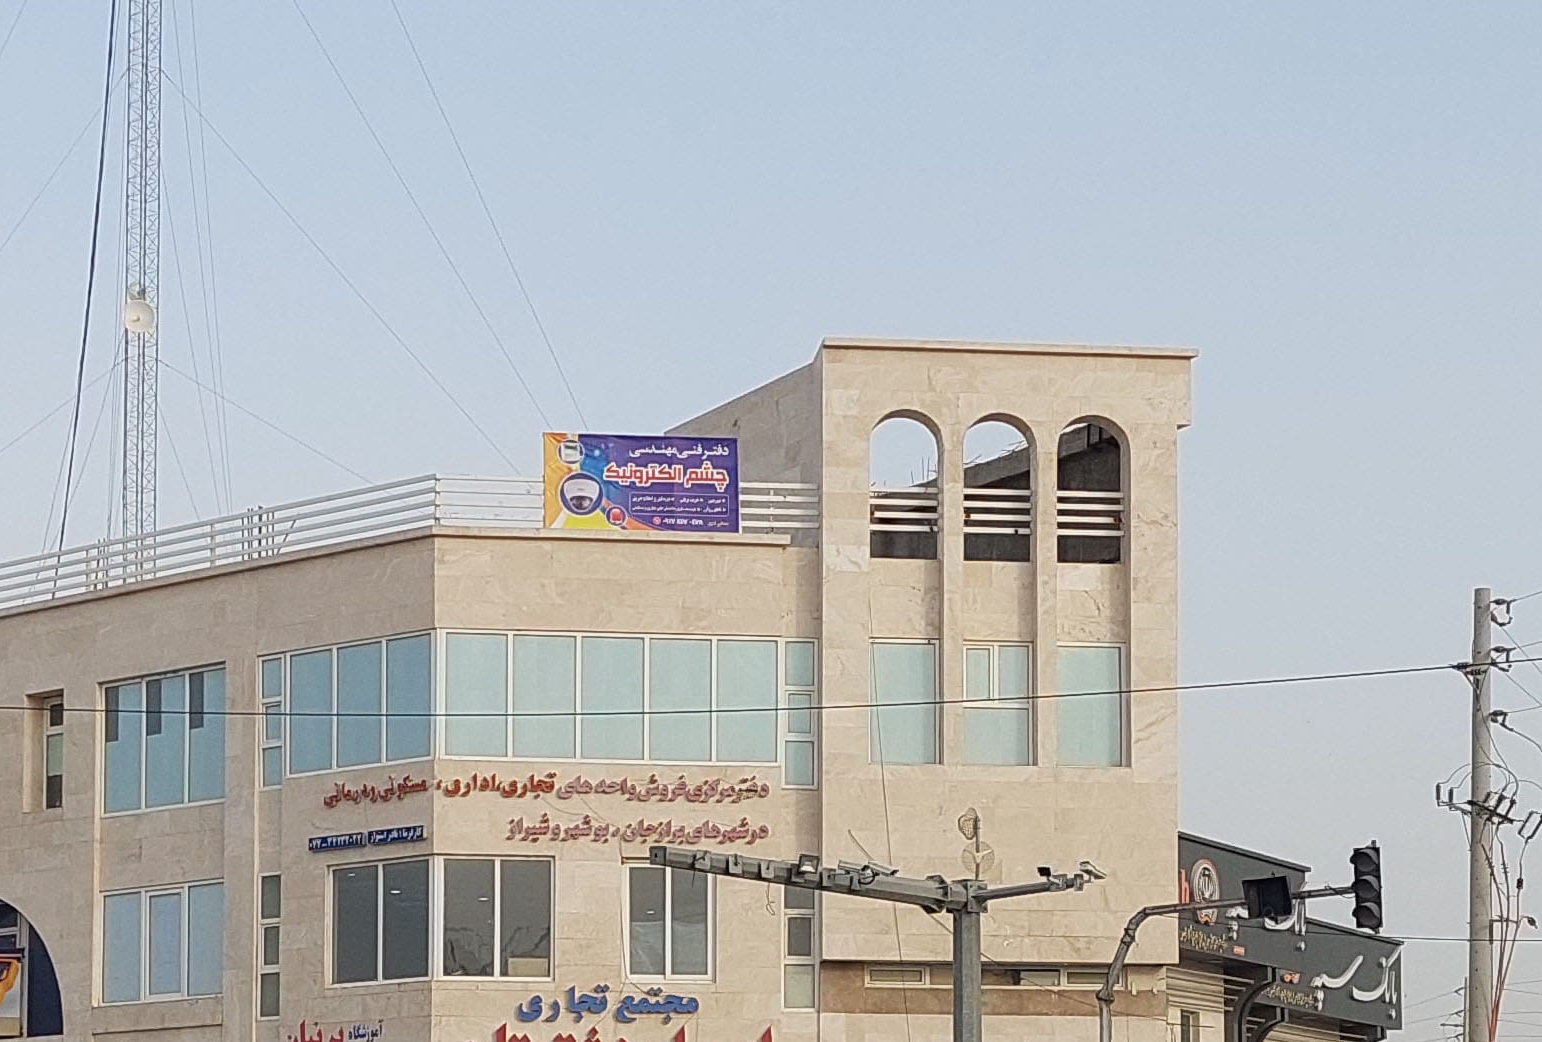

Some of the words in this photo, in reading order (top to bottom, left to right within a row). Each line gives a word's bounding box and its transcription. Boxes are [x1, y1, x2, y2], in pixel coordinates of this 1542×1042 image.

[629, 444, 677, 457] مهندسی
[676, 443, 702, 459] فنی
[701, 443, 729, 459] دفتر
[603, 463, 683, 487] الکترونیک
[684, 461, 729, 492] چشم
[636, 774, 685, 802] فروش
[685, 778, 736, 803] مرکزی
[735, 775, 769, 803] دفتر
[506, 812, 550, 843] شیراز
[560, 814, 609, 843] بوشهر
[515, 983, 611, 1023] تجاری
[614, 986, 700, 1024] مجتمع
